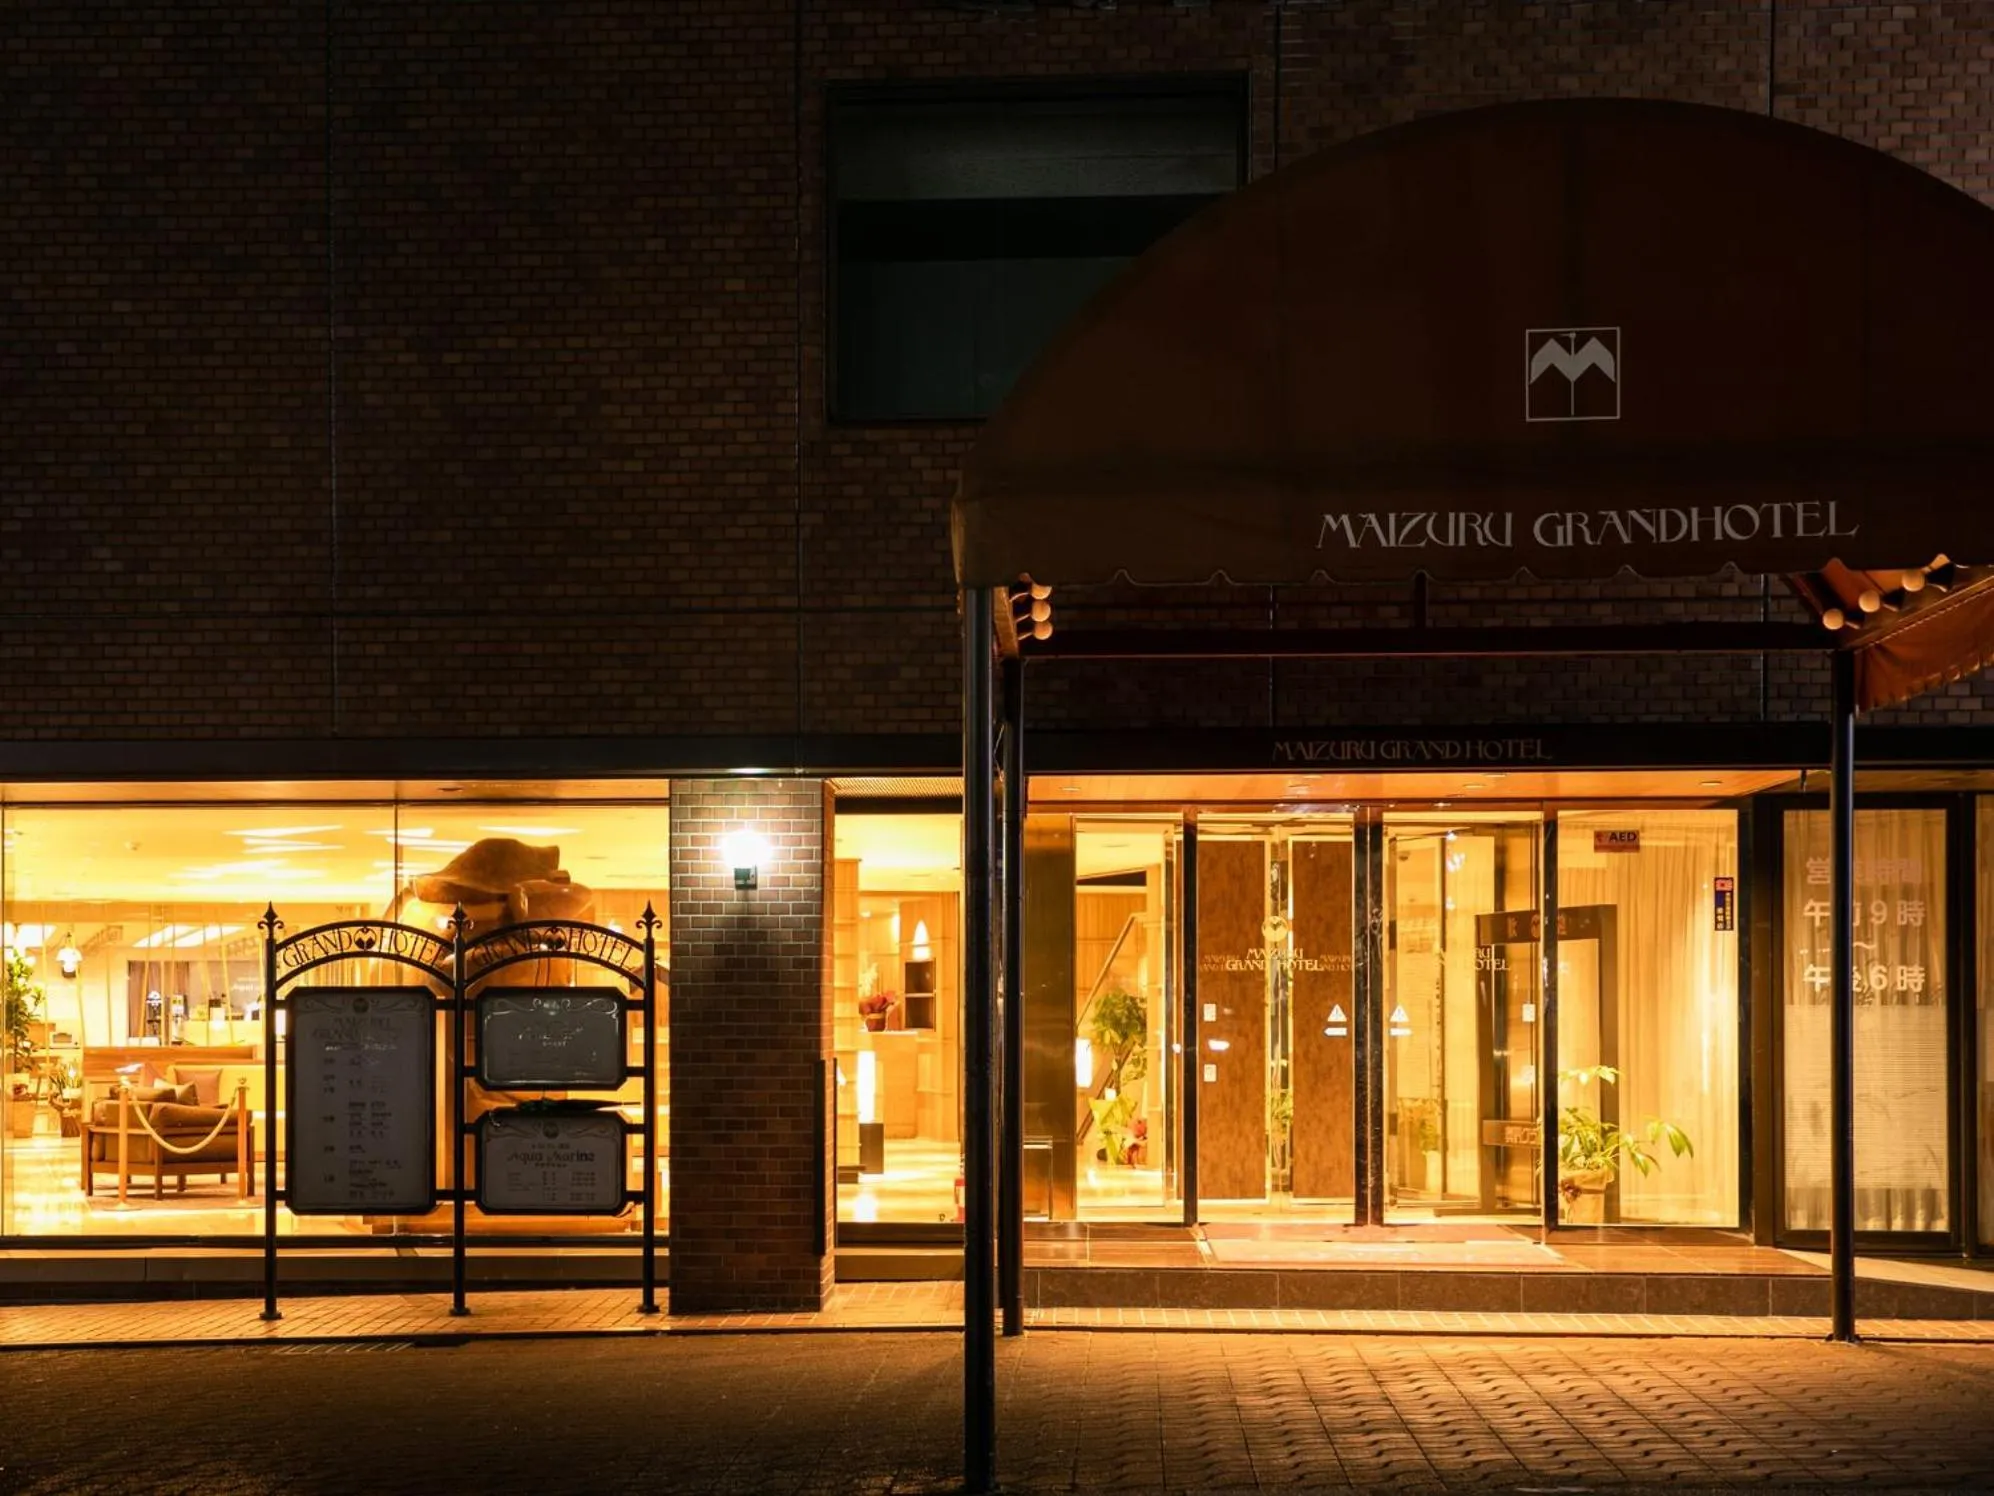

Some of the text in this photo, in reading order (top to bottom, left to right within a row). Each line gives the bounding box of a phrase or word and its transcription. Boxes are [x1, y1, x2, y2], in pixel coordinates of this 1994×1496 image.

[1316, 511, 1513, 548] MAIZURU
[1272, 739, 1553, 761] MAIZURU GRAND HOTEL
[1609, 831, 1637, 841] AED
[283, 927, 447, 969] GRAND HOTEL
[471, 927, 638, 971] GRAND HOTEL
